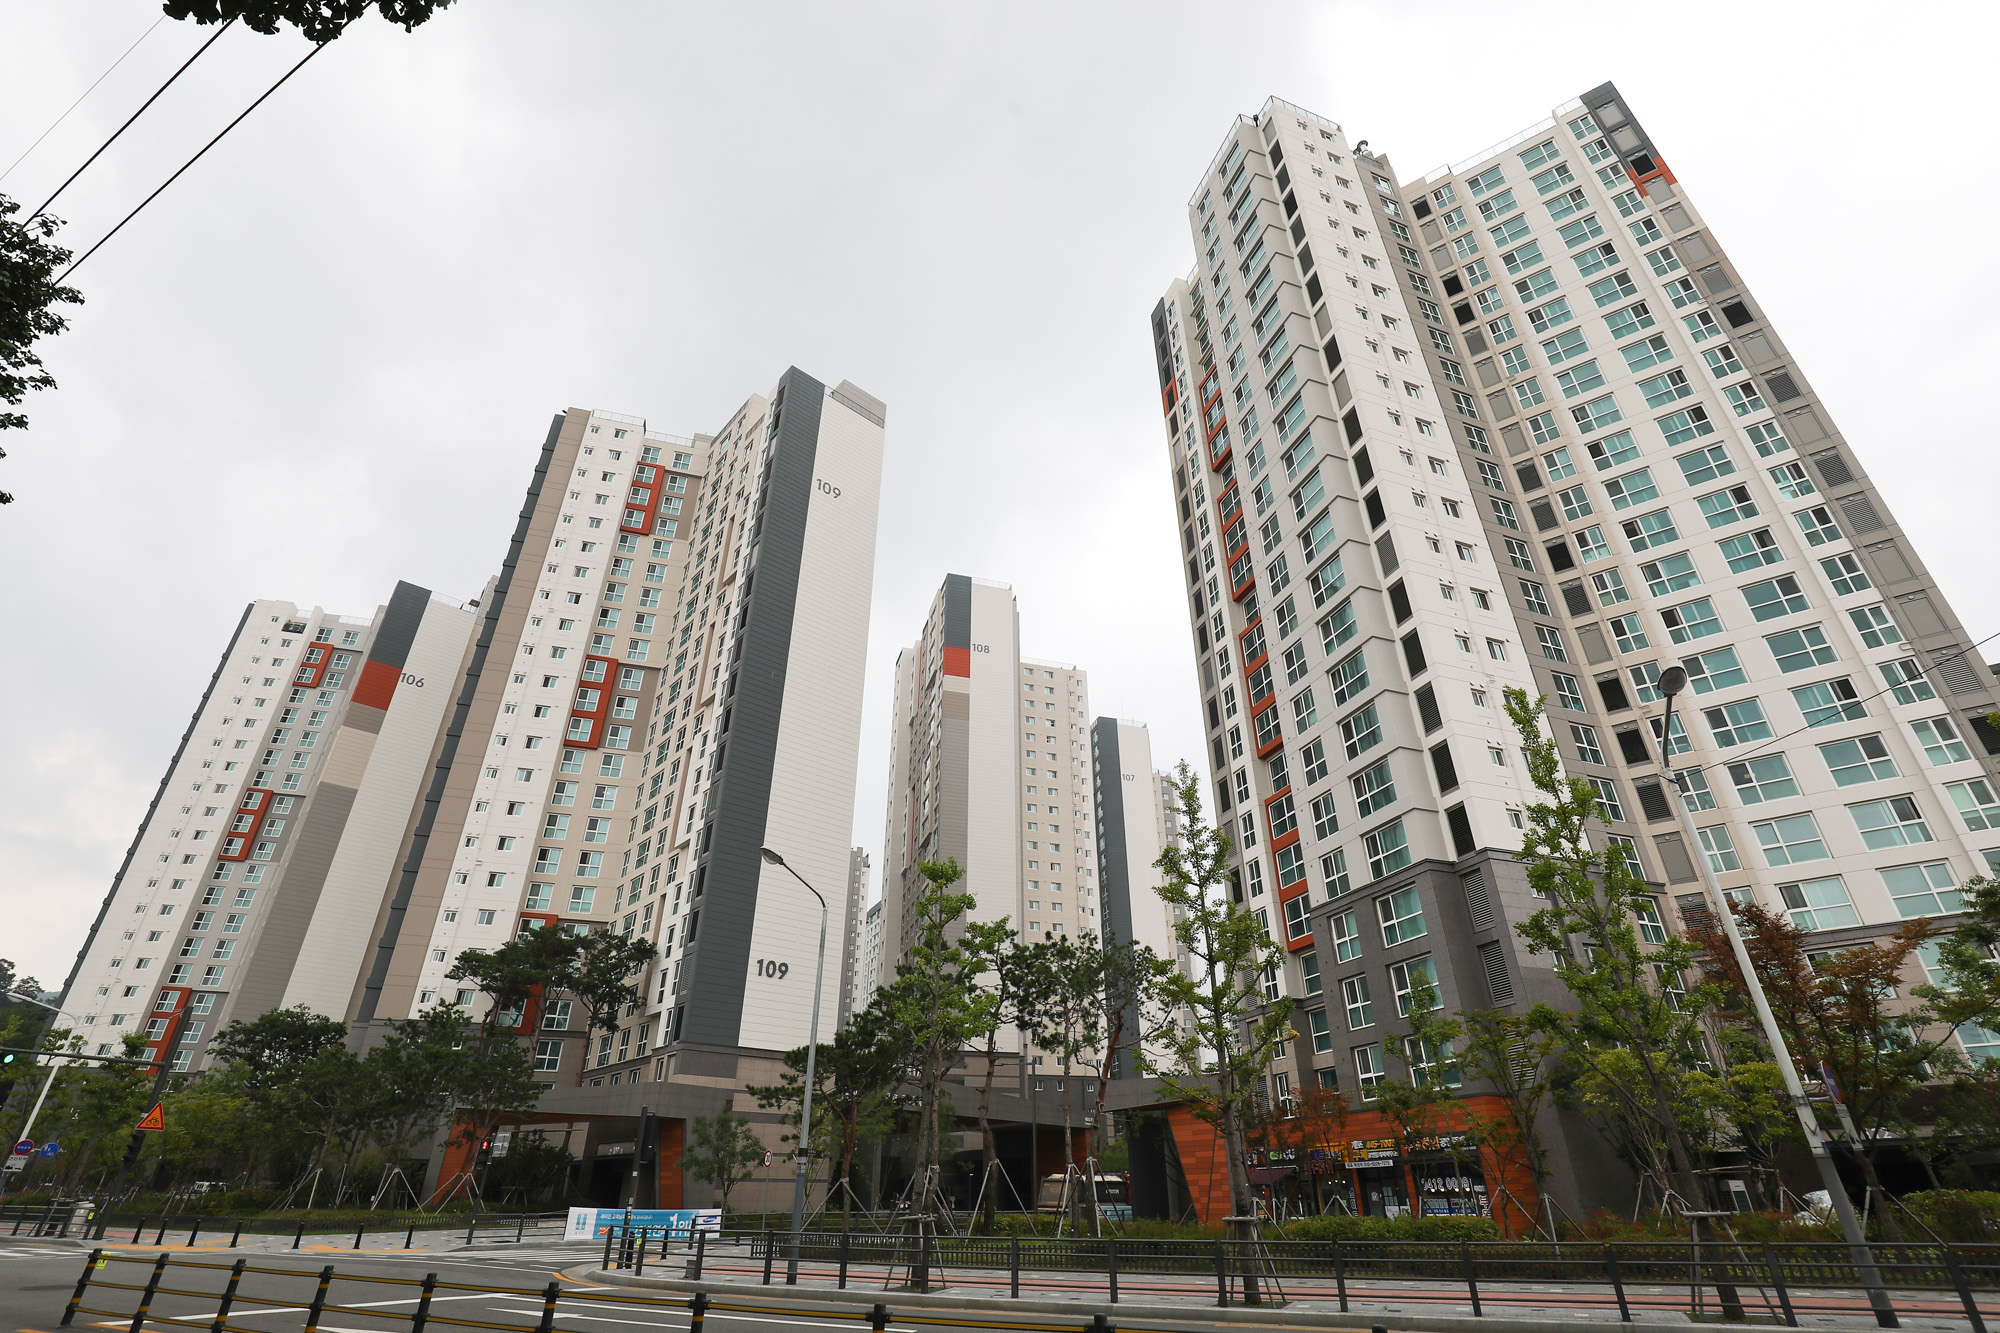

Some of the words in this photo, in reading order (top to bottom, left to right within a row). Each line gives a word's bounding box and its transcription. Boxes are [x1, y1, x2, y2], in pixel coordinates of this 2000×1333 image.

[817, 479, 841, 499] 109
[972, 643, 990, 653] 108
[401, 672, 424, 688] 106
[1122, 773, 1136, 782] 107
[756, 958, 789, 980] 109
